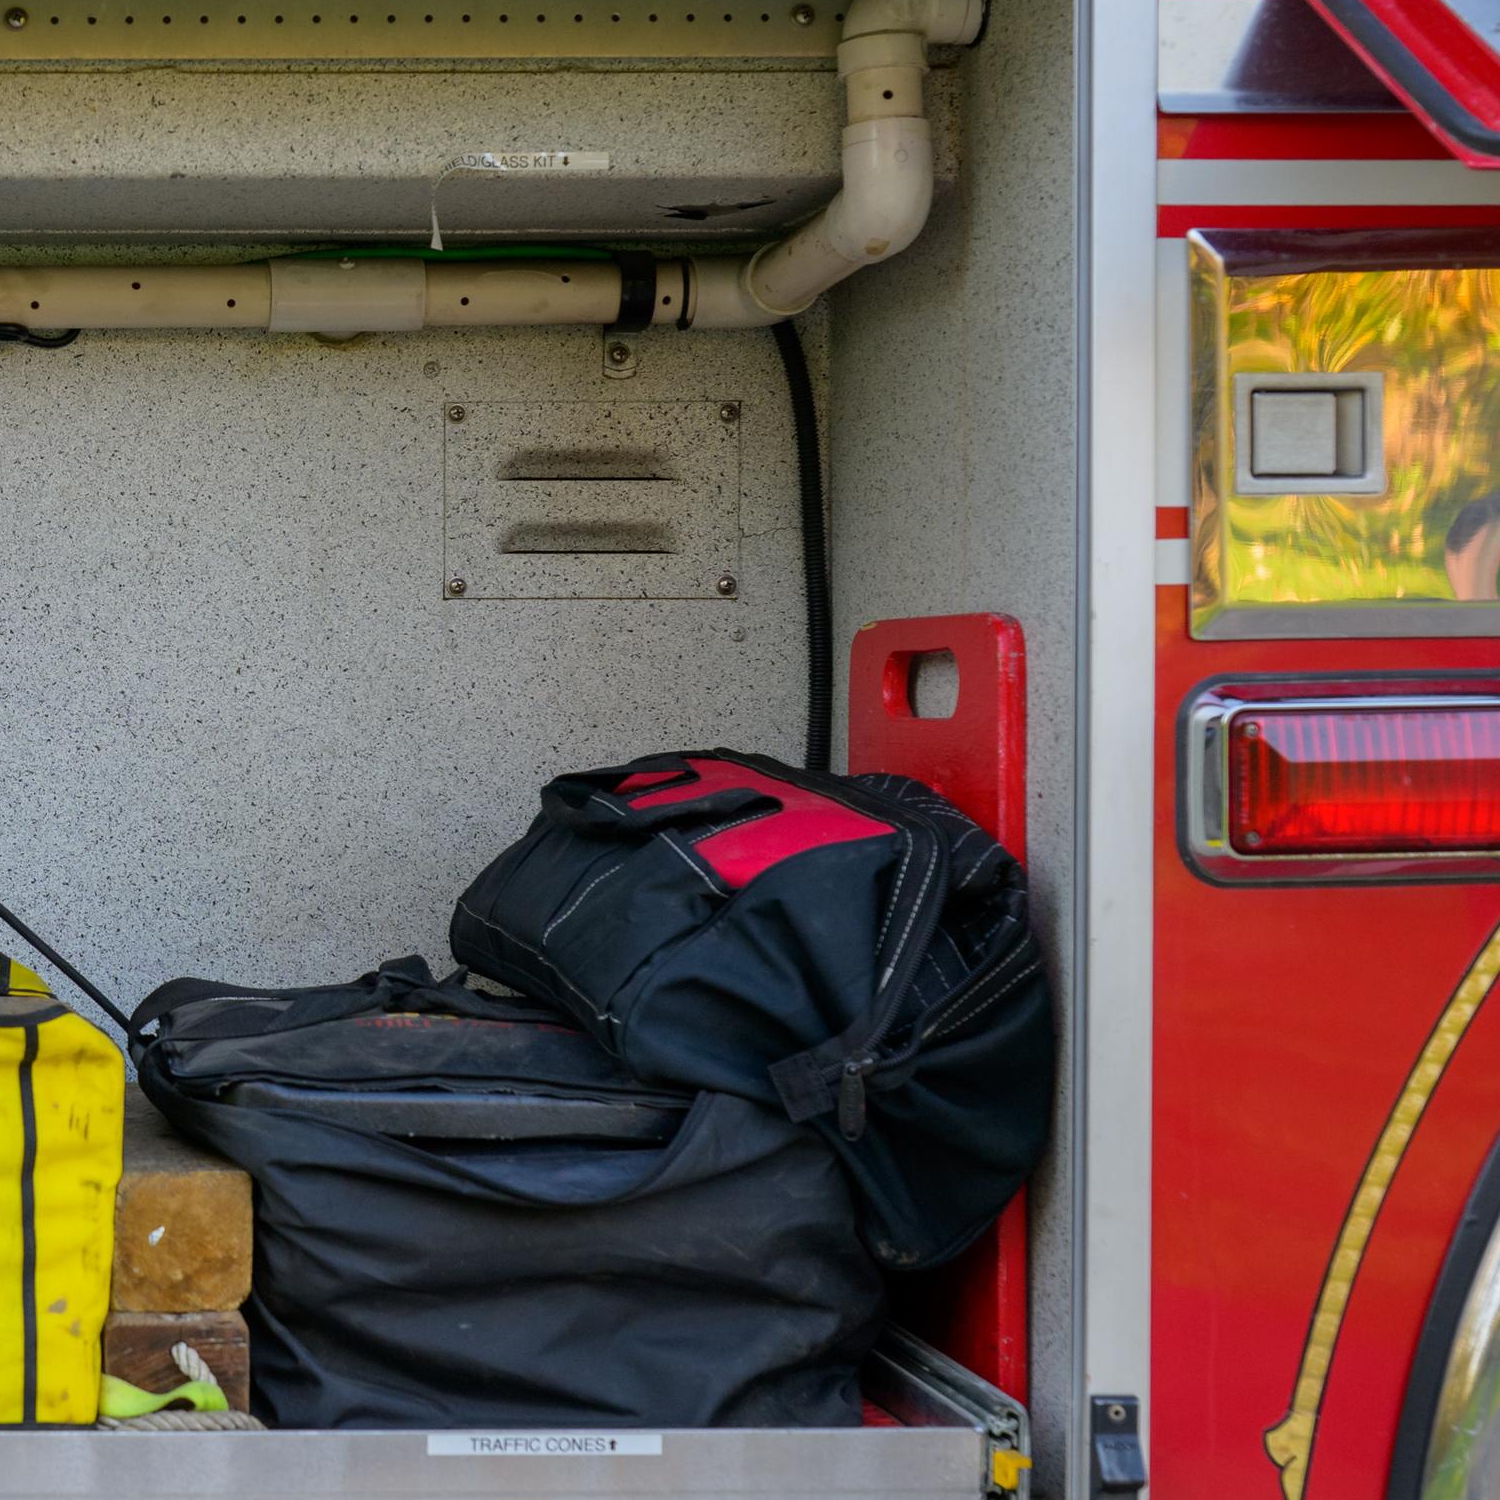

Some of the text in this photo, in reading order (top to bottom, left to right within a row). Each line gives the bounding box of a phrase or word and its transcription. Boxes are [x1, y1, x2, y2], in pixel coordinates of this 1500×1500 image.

[533, 155, 556, 168] KIT
[470, 1437, 606, 1452] TRAFFIC CONES
